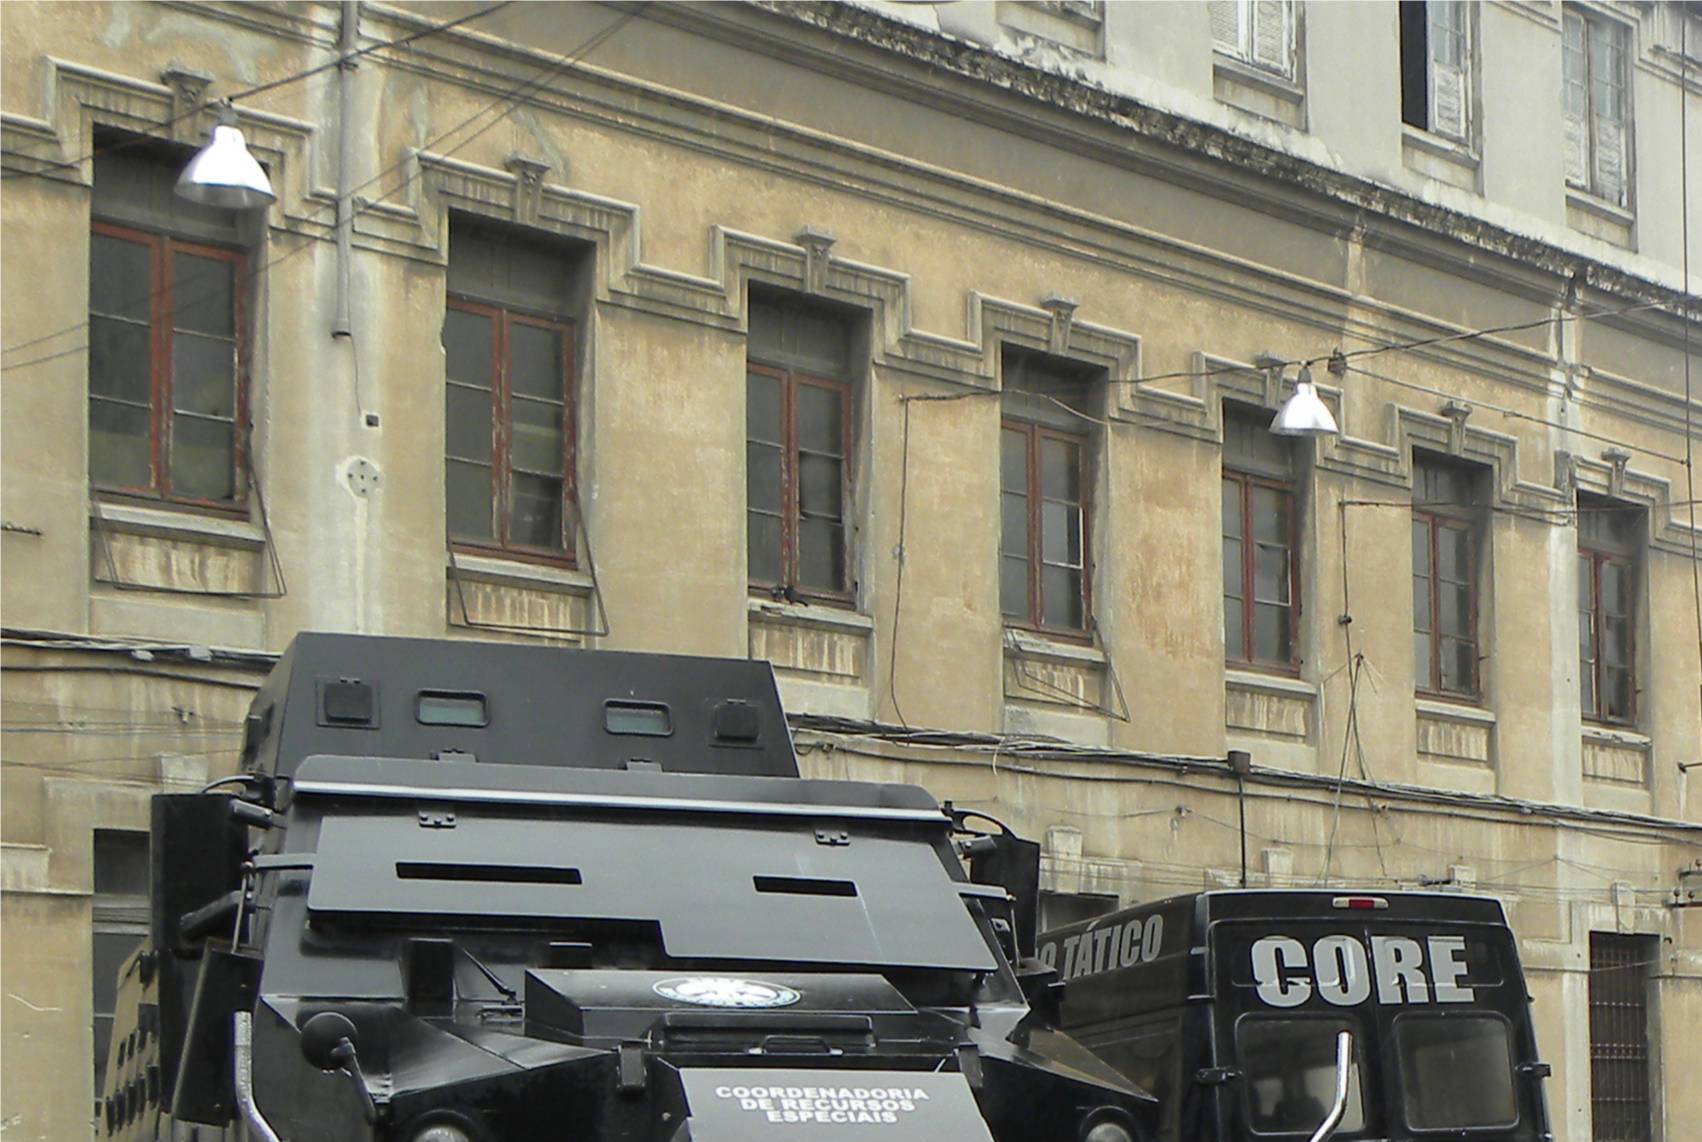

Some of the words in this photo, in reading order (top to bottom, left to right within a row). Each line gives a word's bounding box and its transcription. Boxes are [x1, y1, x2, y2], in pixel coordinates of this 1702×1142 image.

[1062, 914, 1164, 980] TÁTICO
[1251, 934, 1475, 1007] CORE
[715, 1086, 929, 1100] COORDENADORIA
[740, 1098, 774, 1111] DE
[781, 1099, 916, 1112] RECURSOS
[766, 1110, 898, 1123] ESPECIAIS
